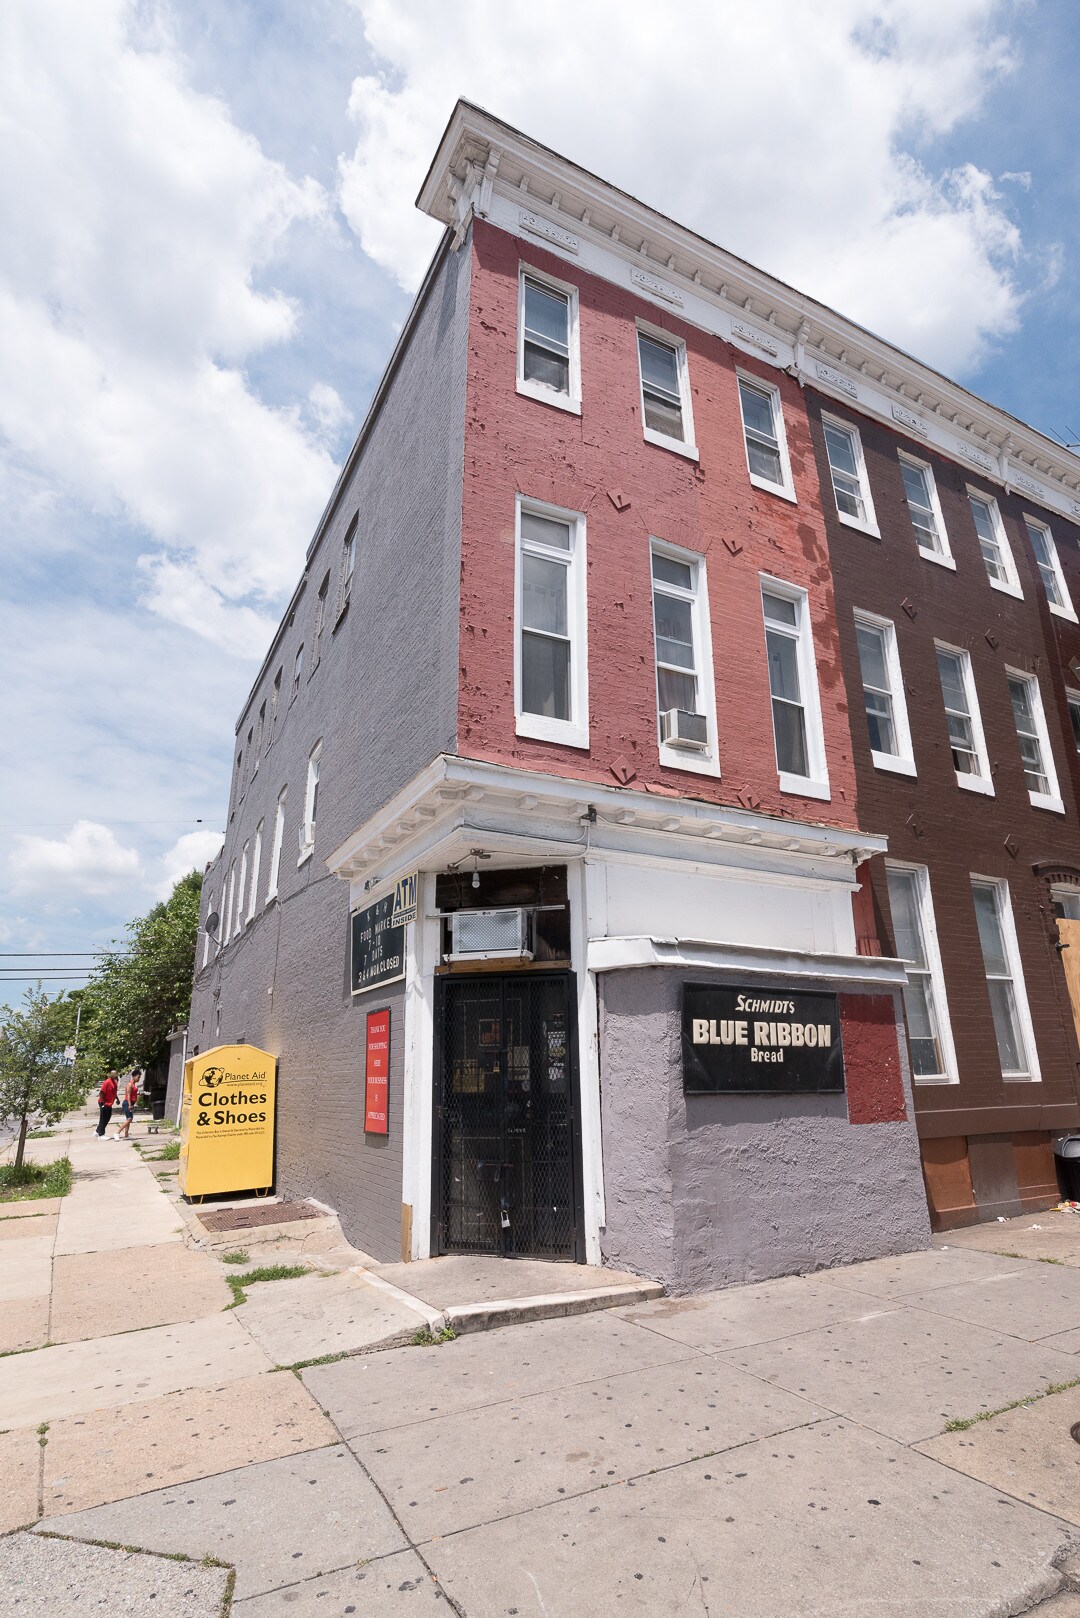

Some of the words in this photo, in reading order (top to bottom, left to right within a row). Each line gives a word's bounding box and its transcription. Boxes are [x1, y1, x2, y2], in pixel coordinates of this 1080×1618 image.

[392, 912, 417, 927] INSIDE
[360, 928, 372, 943] FOOD
[371, 946, 383, 962] DAYS
[735, 994, 795, 1014] SCHMIDTS
[692, 1018, 749, 1046] BLUE
[753, 1021, 832, 1048] RIBBON
[750, 1047, 784, 1063] Bread
[225, 1072, 250, 1081] Planet
[252, 1071, 266, 1080] Aid
[198, 1091, 267, 1107] Clothes
[196, 1111, 211, 1127] &
[213, 1110, 267, 1125] Shoes
